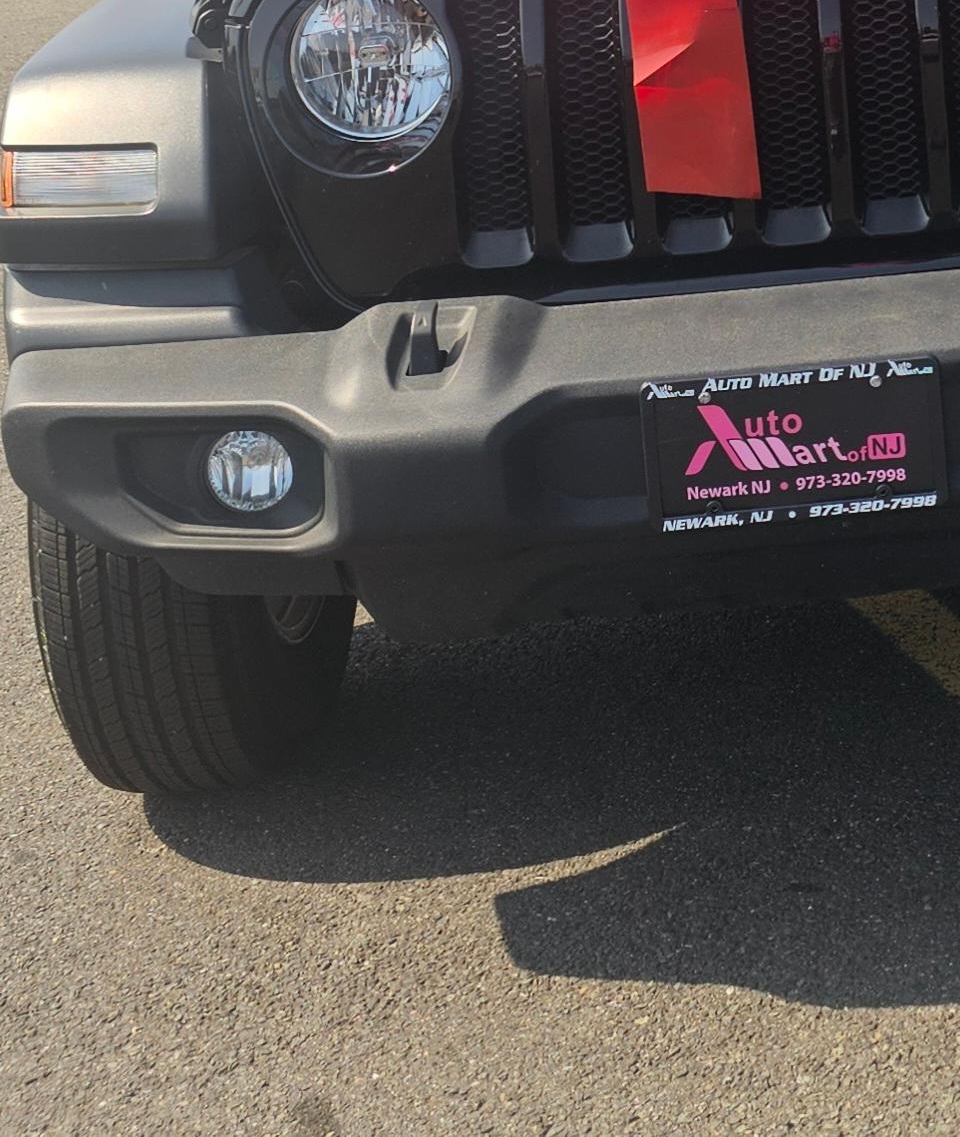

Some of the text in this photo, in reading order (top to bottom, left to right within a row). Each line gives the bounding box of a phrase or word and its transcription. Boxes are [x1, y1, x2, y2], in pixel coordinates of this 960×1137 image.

[849, 363, 876, 378] NJ
[848, 445, 868, 463] of
[872, 436, 902, 456] NJ
[687, 468, 906, 500] Newark NJ 973-320-7998
[663, 495, 937, 532] NEWARK, NJ 973-320-7998
